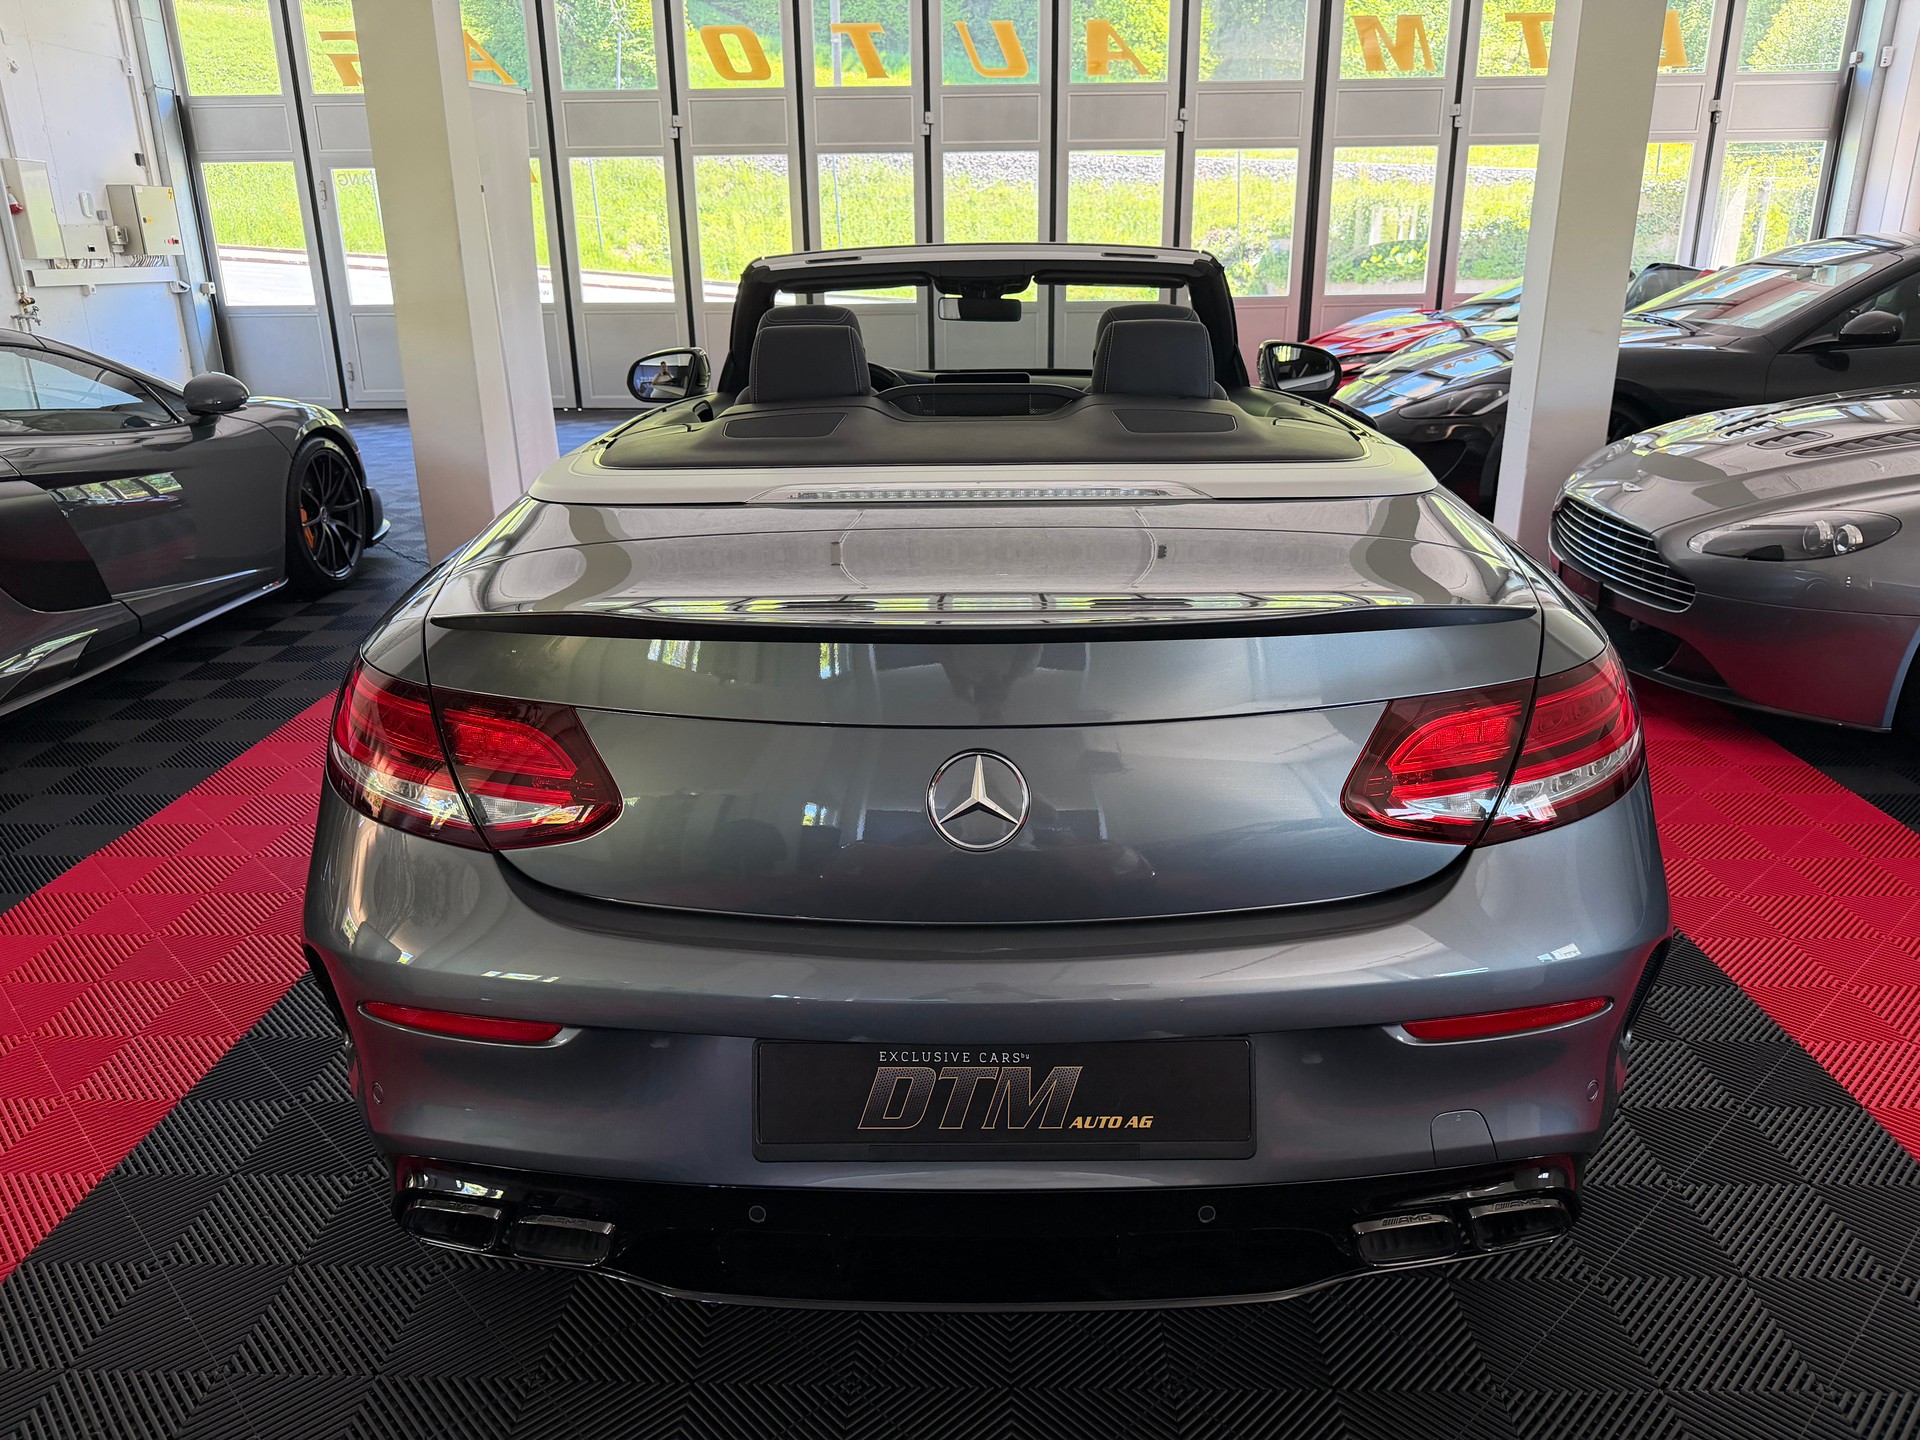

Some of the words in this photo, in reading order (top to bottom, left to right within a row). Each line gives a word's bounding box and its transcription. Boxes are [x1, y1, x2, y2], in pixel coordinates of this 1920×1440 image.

[879, 1051, 971, 1063] EXCLUSIVE
[979, 1052, 1021, 1064] CARS
[857, 1066, 1084, 1130] DTM
[1068, 1115, 1124, 1130] AUTO
[1124, 1115, 1154, 1129] AG
